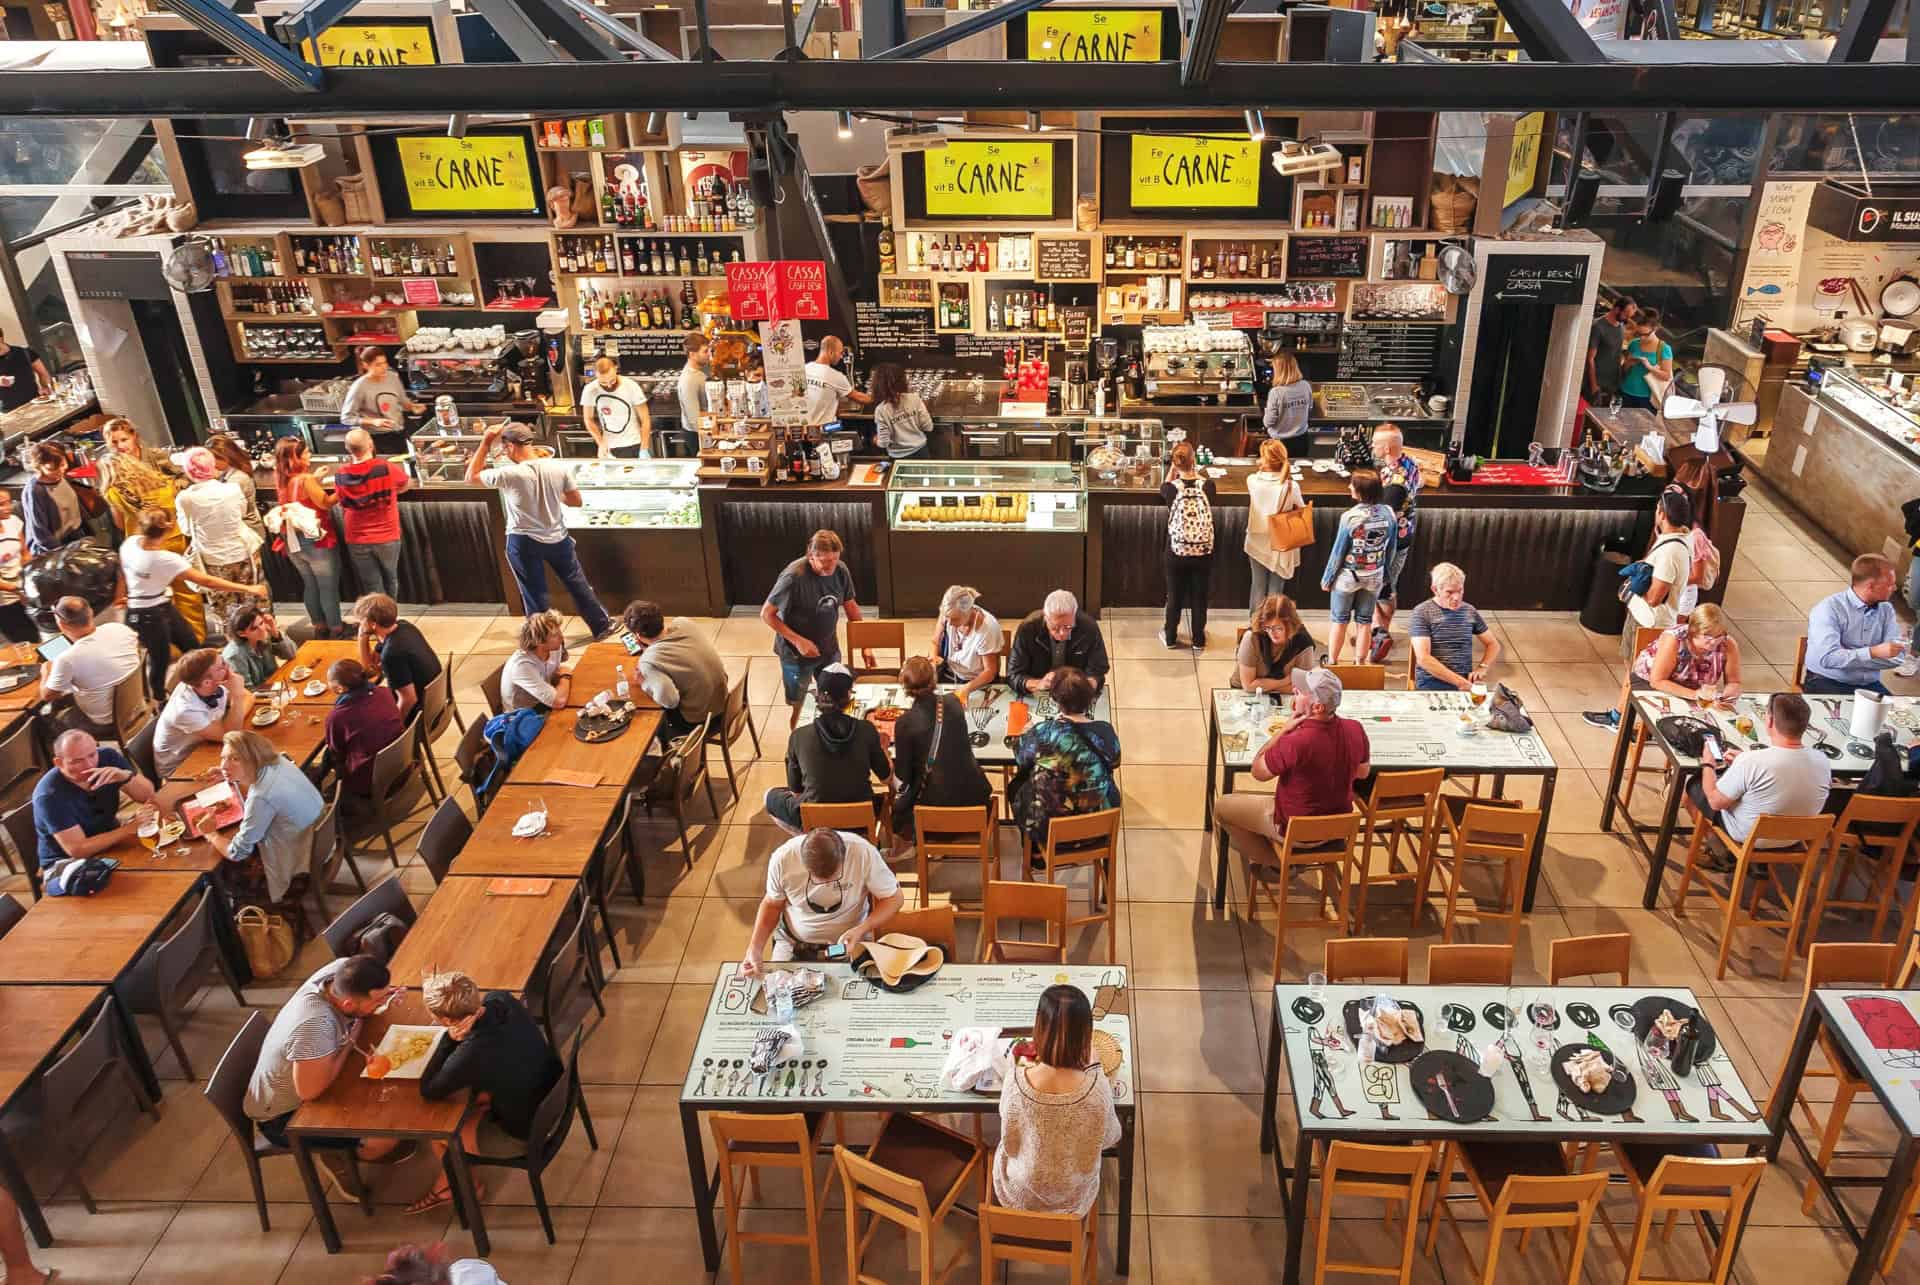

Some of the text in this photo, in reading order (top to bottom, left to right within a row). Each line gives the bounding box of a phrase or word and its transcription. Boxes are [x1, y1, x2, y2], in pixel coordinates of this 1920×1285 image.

[1093, 13, 1107, 24] Se
[1046, 26, 1058, 36] Fe
[1151, 148, 1163, 157] Fe
[435, 156, 505, 190] CARNE
[1163, 152, 1236, 189] CARNE
[956, 161, 1028, 197] CARNE
[1893, 211, 1903, 222] IL
[730, 266, 766, 281] CASSA
[787, 265, 823, 280] CASSA
[1510, 268, 1542, 279] CASH
[1505, 280, 1543, 290] CASSA
